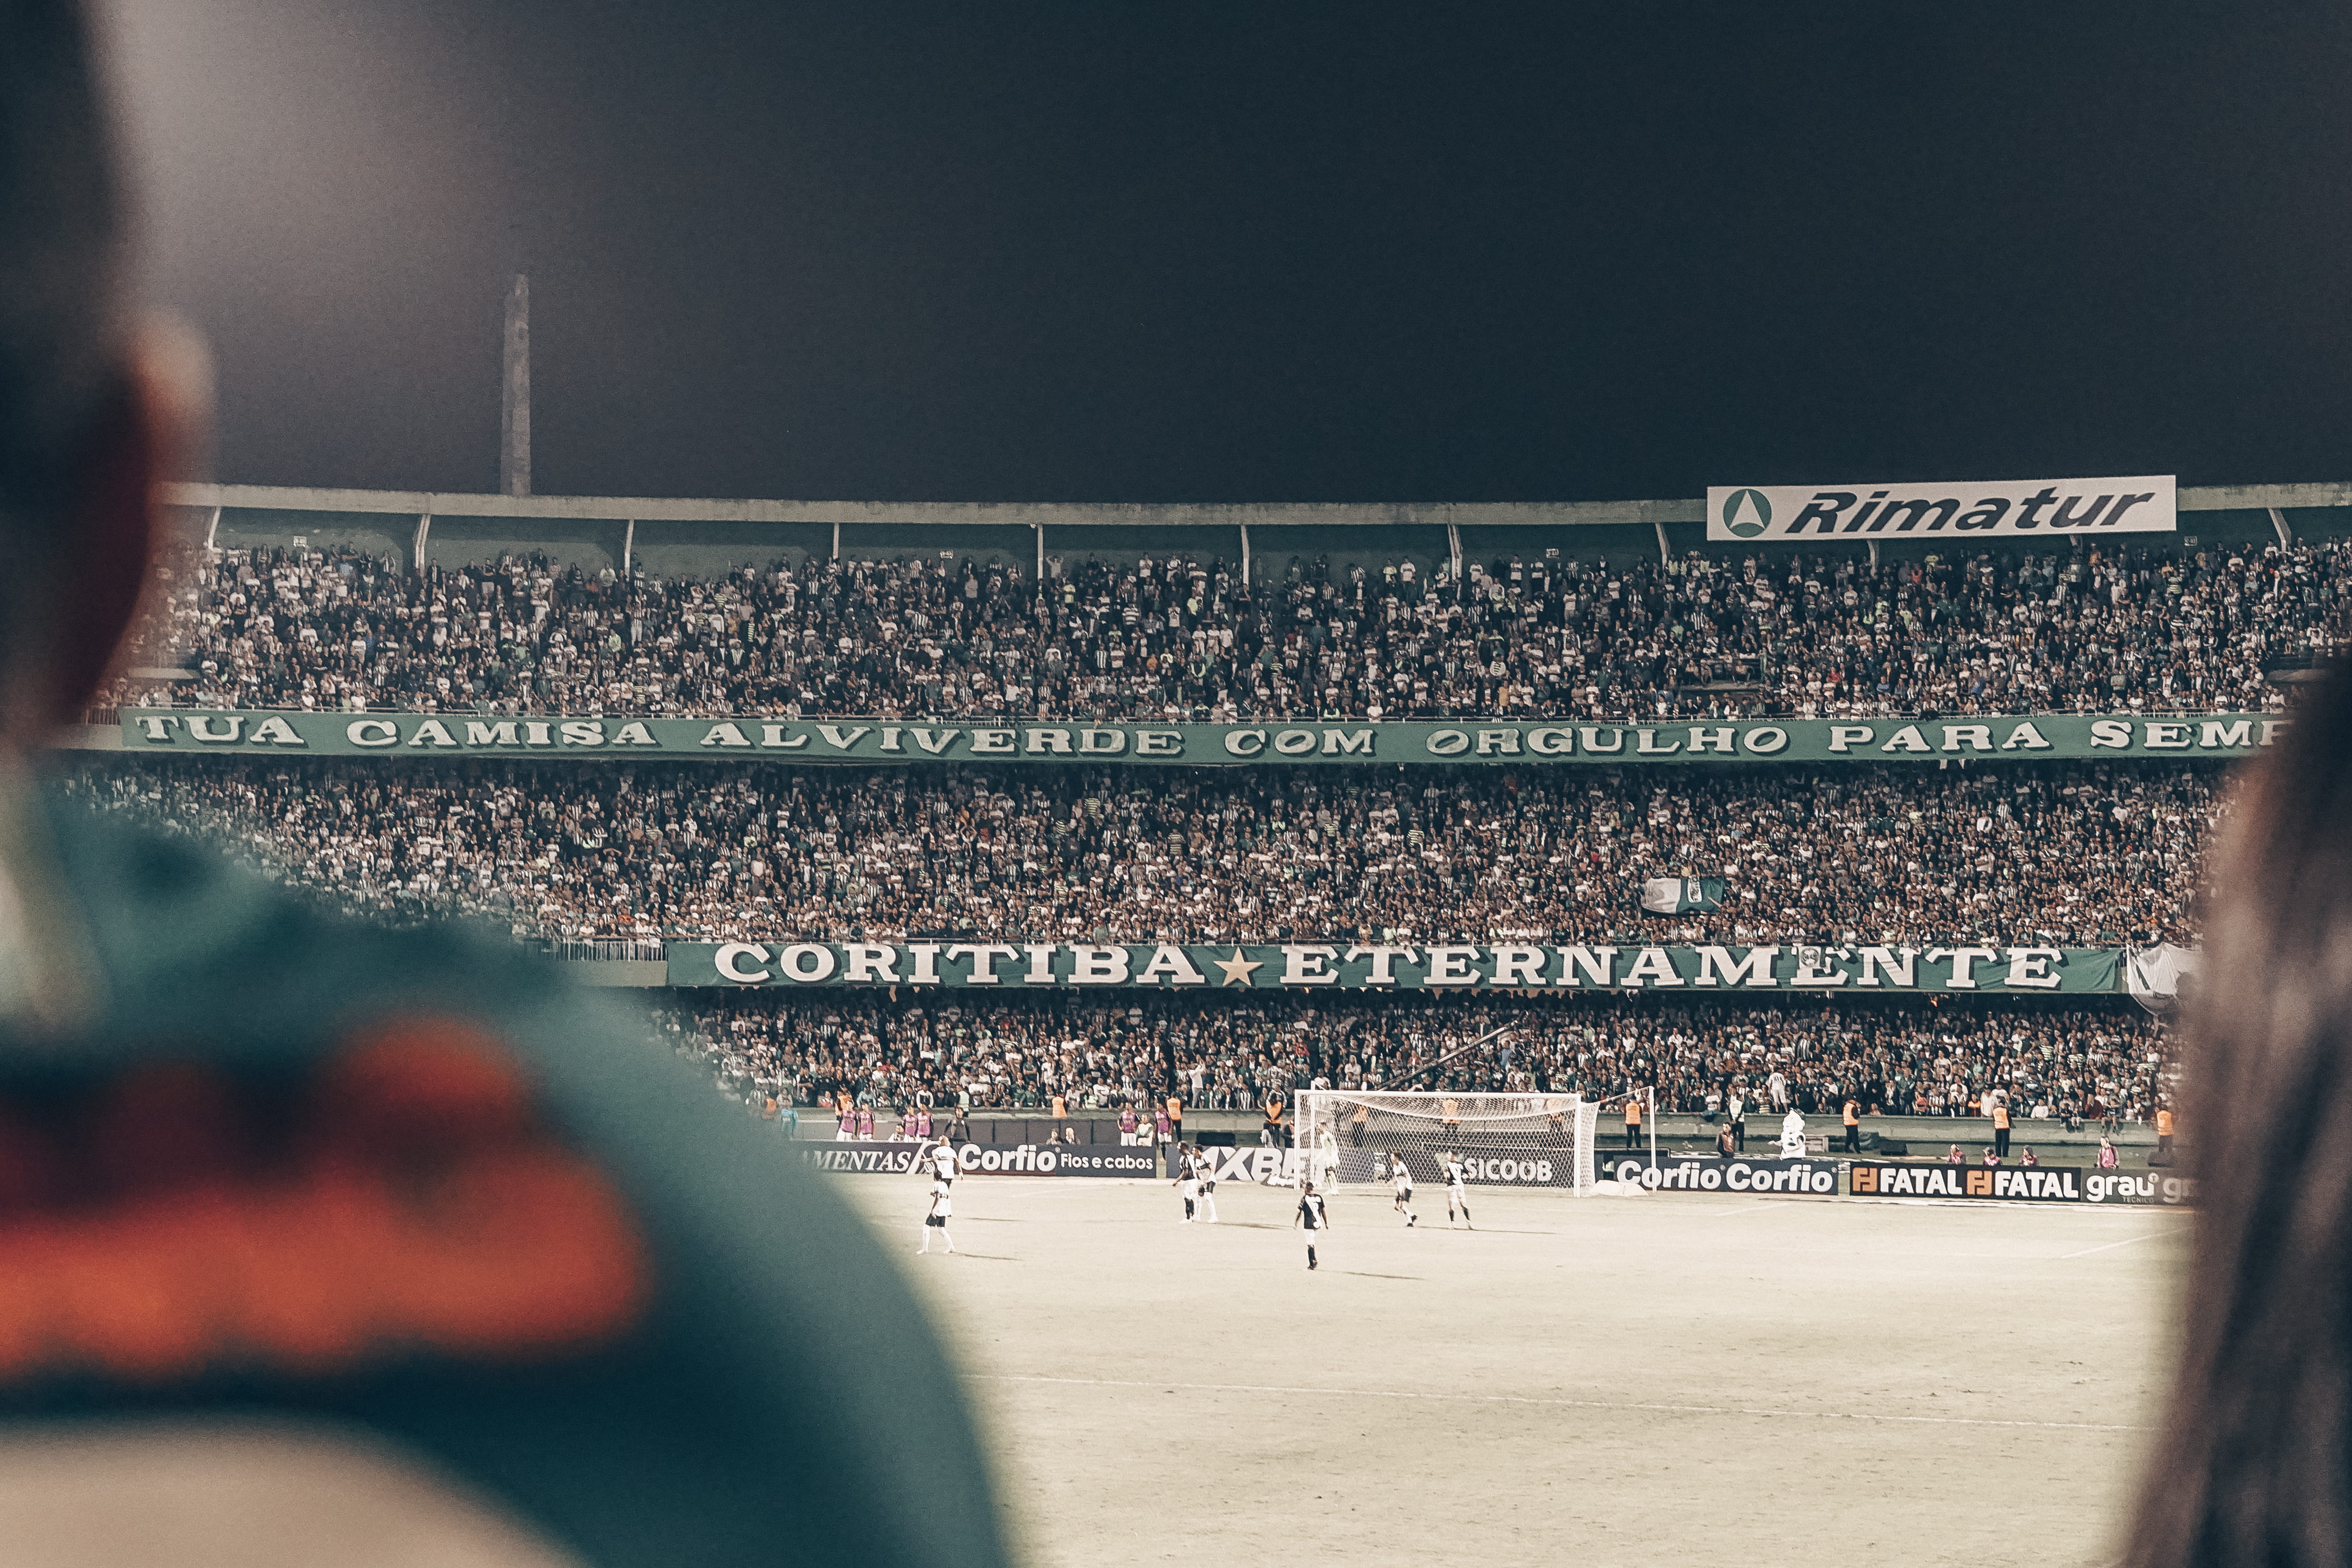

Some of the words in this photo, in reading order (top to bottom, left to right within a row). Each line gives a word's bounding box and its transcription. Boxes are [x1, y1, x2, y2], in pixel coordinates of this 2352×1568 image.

[1784, 487, 2156, 534] Rimatur
[135, 716, 305, 744] TUA
[347, 719, 657, 746] CAMISA
[699, 722, 1183, 754] ALVIVERDE
[1224, 729, 1376, 755] COM
[1425, 727, 1788, 754] ORGULHO
[1828, 721, 2050, 752] PARA
[714, 942, 1204, 985] CORITIBA
[1279, 943, 2062, 989] ETERNAMENTE
[803, 1150, 912, 1172] MENTAS
[958, 1143, 1057, 1172] Corfio
[1060, 1152, 1089, 1169] Fios
[1091, 1156, 1102, 1169] e
[1104, 1155, 1154, 1170] cabos
[1463, 1157, 1553, 1182] SICOOB
[1617, 1160, 1722, 1190] Corfio
[1726, 1162, 1831, 1193] Corfio
[1880, 1168, 1963, 1195] FATAL
[1994, 1170, 2079, 1198] FATAL
[2086, 1175, 2154, 1202] grau
